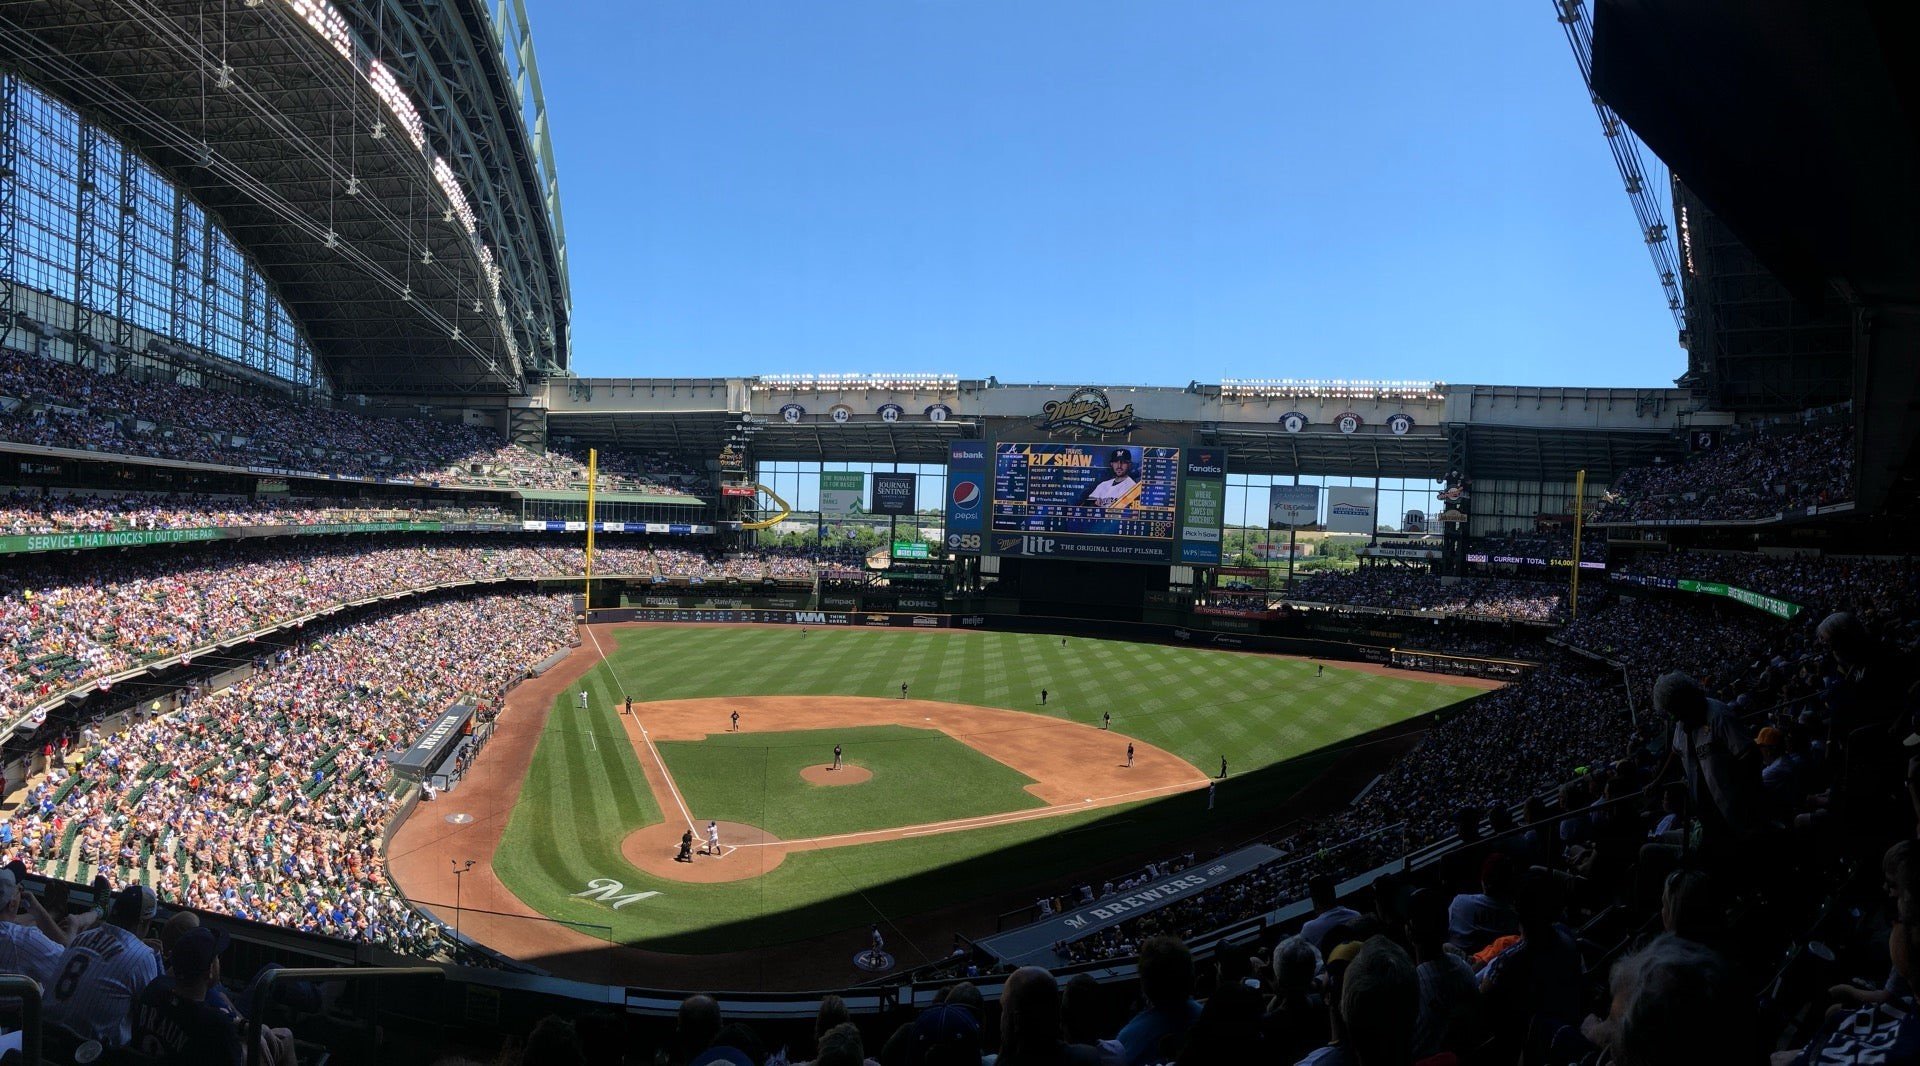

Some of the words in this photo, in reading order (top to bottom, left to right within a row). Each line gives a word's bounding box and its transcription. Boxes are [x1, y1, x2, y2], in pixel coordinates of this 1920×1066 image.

[786, 411, 798, 419] 34
[835, 411, 847, 419] 42
[884, 411, 896, 419] 44
[935, 412, 940, 420] 1
[1043, 401, 1097, 421] Miller
[1090, 404, 1134, 425] Park
[1289, 420, 1296, 428] 4
[1395, 422, 1406, 431] 19
[1033, 454, 1043, 465] 21
[1054, 454, 1093, 467] SHAW
[1189, 464, 1221, 473] Fanatics
[878, 481, 911, 489] JOURNAL
[877, 488, 911, 496] SENTINEL
[1189, 499, 1216, 507] WISCONSIN
[1207, 508, 1214, 516] ON
[1407, 514, 1423, 525] Lite
[28, 535, 75, 550] SERVICE
[79, 533, 104, 547] THAT
[106, 532, 143, 545] KNOCKS
[145, 532, 154, 543] IT
[155, 531, 171, 541] OUT
[172, 531, 184, 540] OF
[185, 530, 199, 539] THE
[960, 534, 981, 548] 58
[997, 539, 1023, 551] Miller
[1021, 535, 1055, 555] Lite
[1076, 545, 1109, 553] ORIGINAL
[1183, 549, 1198, 557] WPS
[1494, 555, 1524, 564] CURRENT
[646, 597, 678, 605] FRIDAYS
[899, 600, 938, 608] KOHL'S
[796, 612, 826, 622] WM
[962, 616, 984, 626] meijer
[432, 715, 460, 735] MILLER
[417, 734, 443, 750] PARK
[1089, 874, 1207, 920] BREWERS
[55, 952, 91, 999] 8
[140, 1003, 190, 1054] BRAUN
